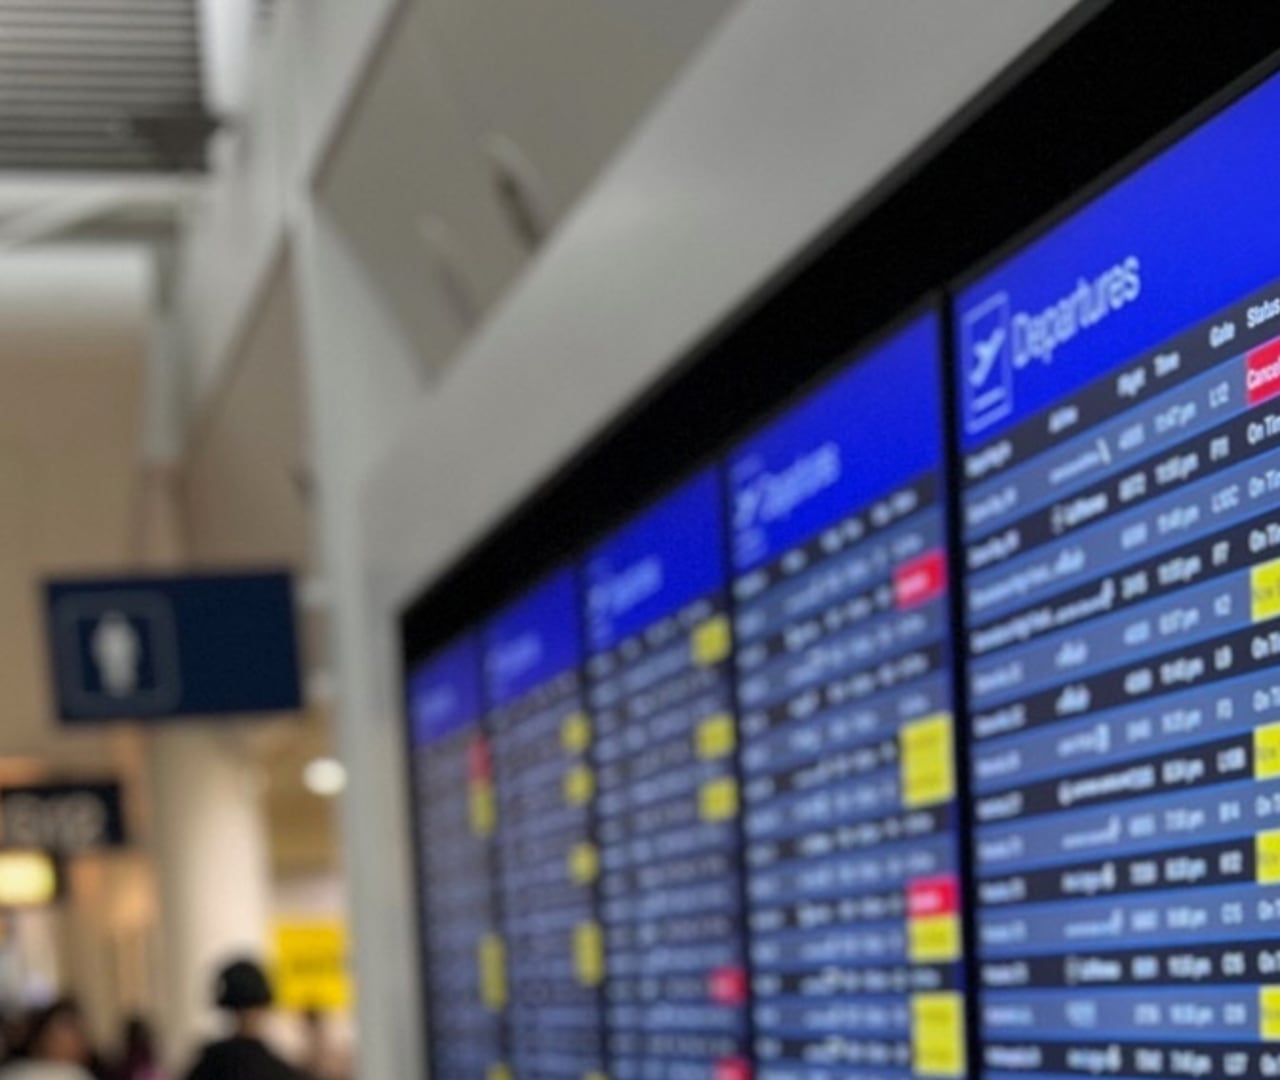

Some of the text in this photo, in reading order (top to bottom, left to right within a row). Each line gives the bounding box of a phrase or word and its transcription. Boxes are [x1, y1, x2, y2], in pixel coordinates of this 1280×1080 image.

[1011, 255, 1141, 370] Departures
[1246, 421, 1265, 445] On
[1247, 476, 1266, 499] On
